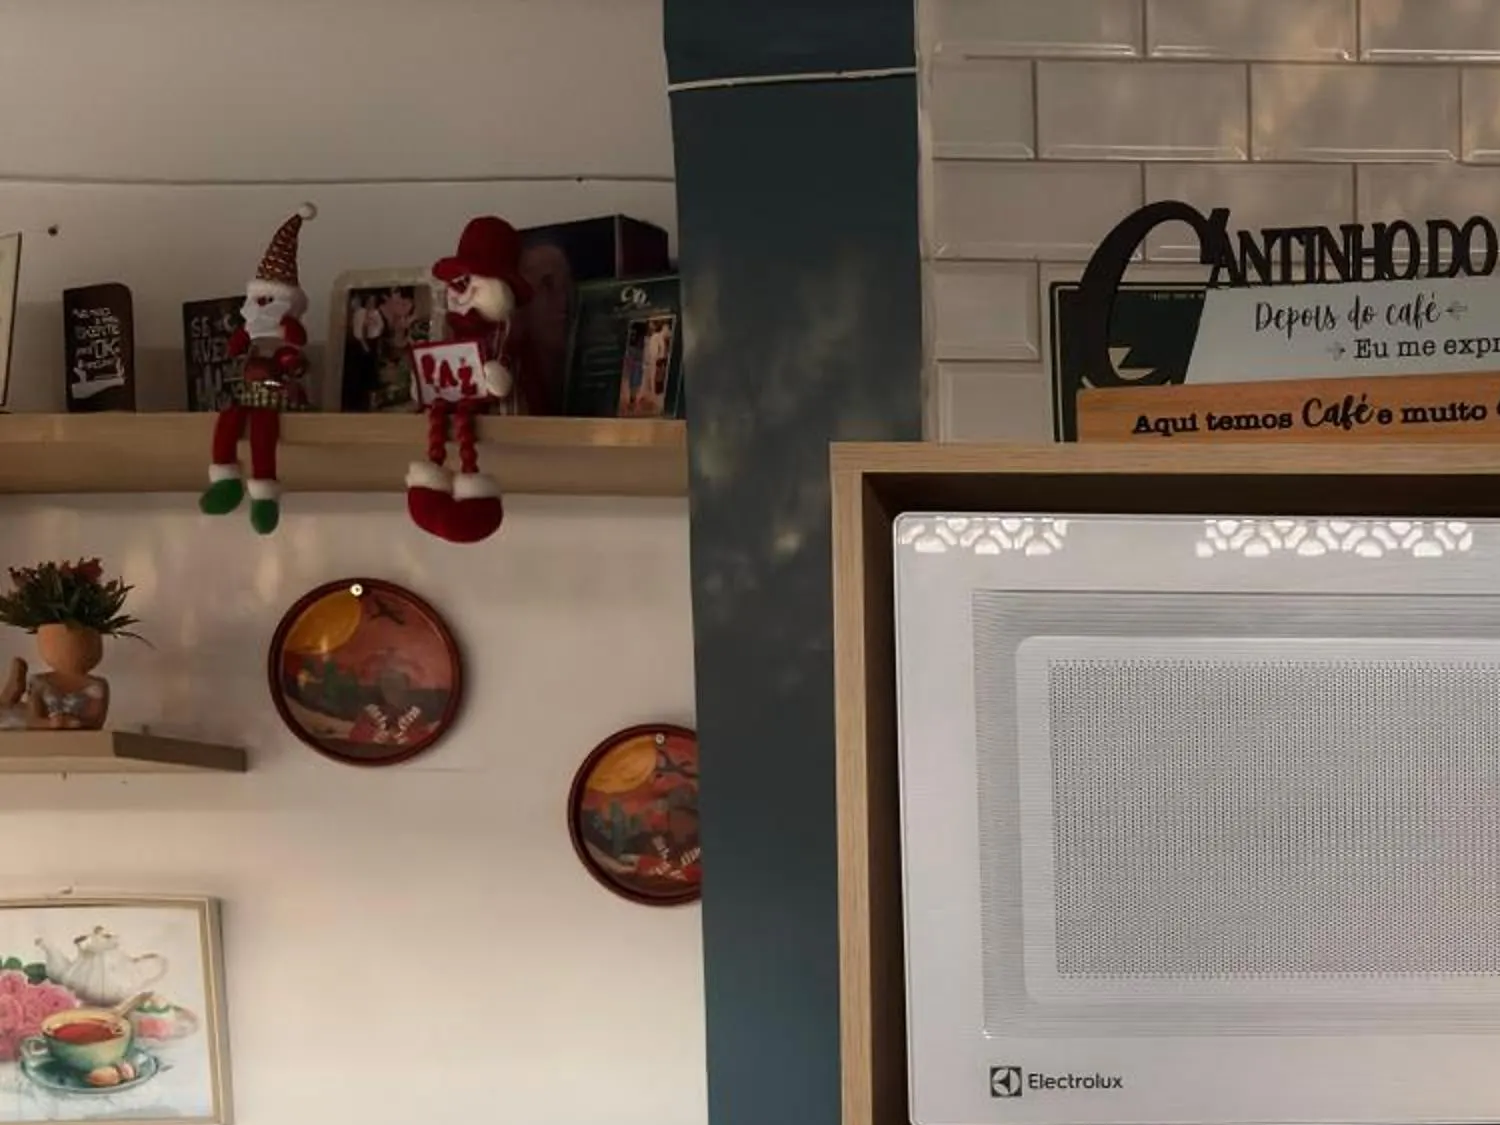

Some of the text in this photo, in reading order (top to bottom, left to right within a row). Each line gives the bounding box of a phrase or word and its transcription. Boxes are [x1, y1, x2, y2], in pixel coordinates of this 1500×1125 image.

[1425, 217, 1500, 278] DO
[1255, 292, 1441, 340] Depois do café
[1353, 337, 1389, 359] Eu
[1399, 338, 1436, 357] me
[1131, 411, 1199, 437] Aqui
[1206, 410, 1292, 431] temos
[1302, 393, 1375, 428] Café
[1378, 410, 1393, 425] e
[1401, 402, 1488, 424] muito
[1027, 1073, 1124, 1090] Electrolux
